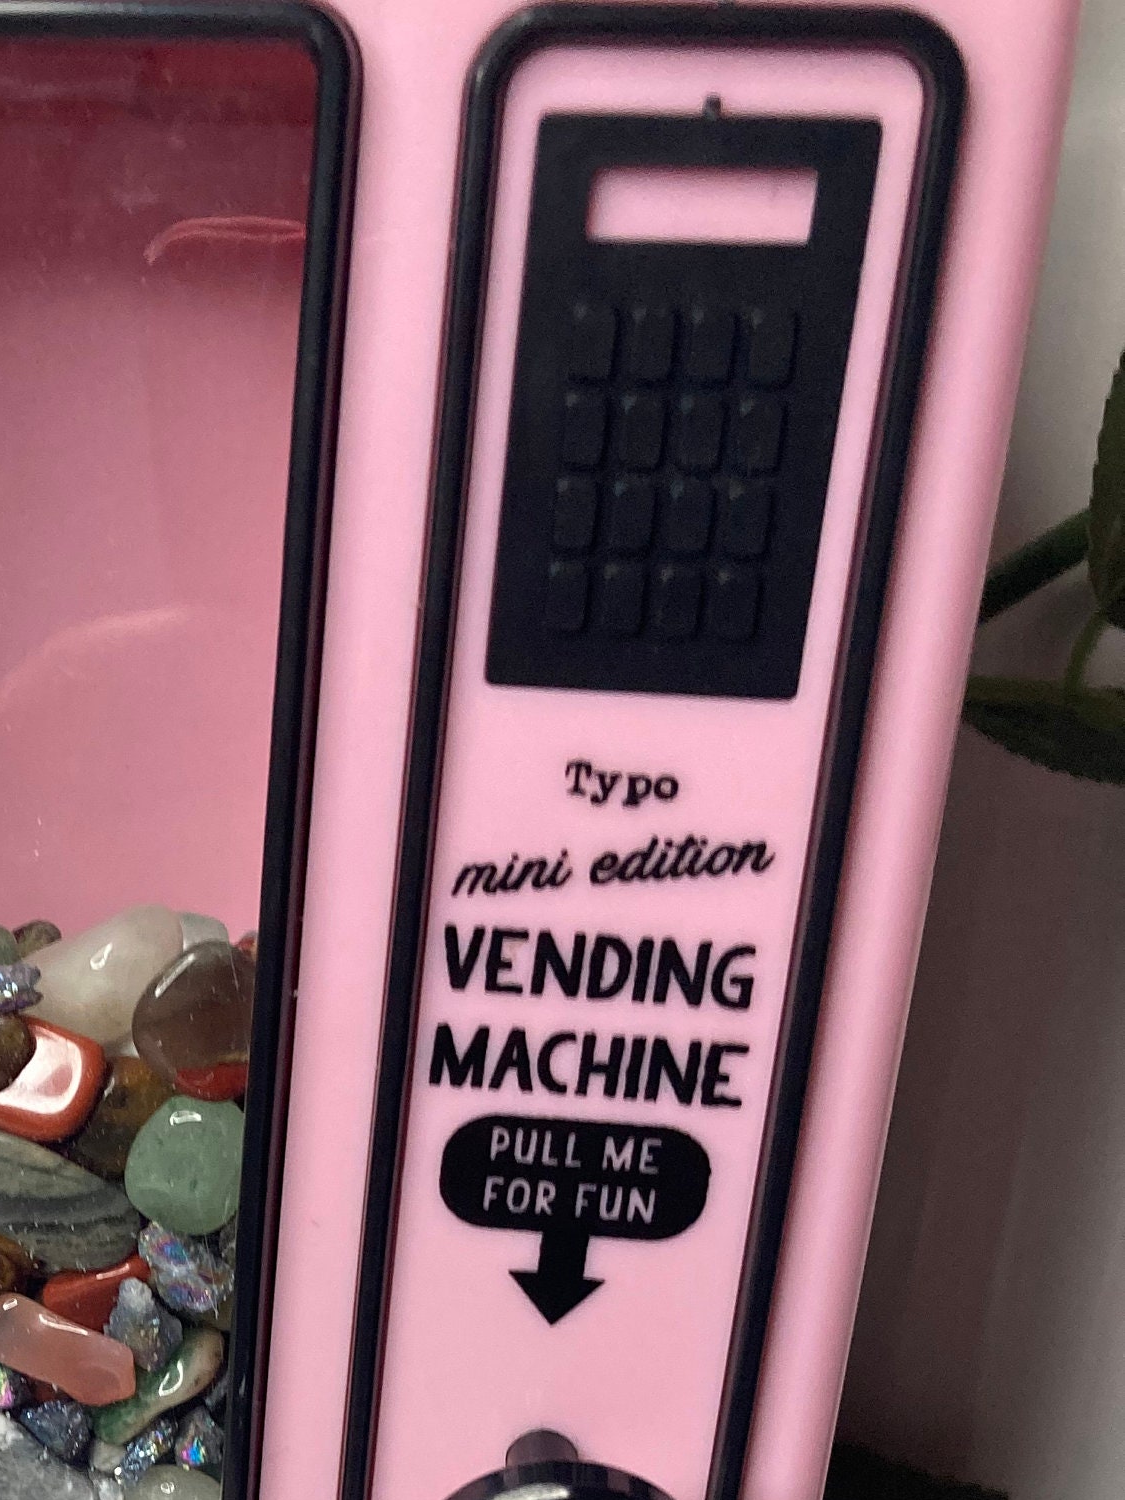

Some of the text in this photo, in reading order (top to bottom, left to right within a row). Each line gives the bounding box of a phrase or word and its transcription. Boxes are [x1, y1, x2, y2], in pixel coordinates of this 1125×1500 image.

[565, 760, 679, 807] Typo
[452, 834, 775, 896] mini edition
[444, 923, 757, 1010] VENDING
[428, 1023, 750, 1108] MACHINE
[489, 1127, 663, 1173] PULL ME
[482, 1177, 657, 1224] FOR FUN
